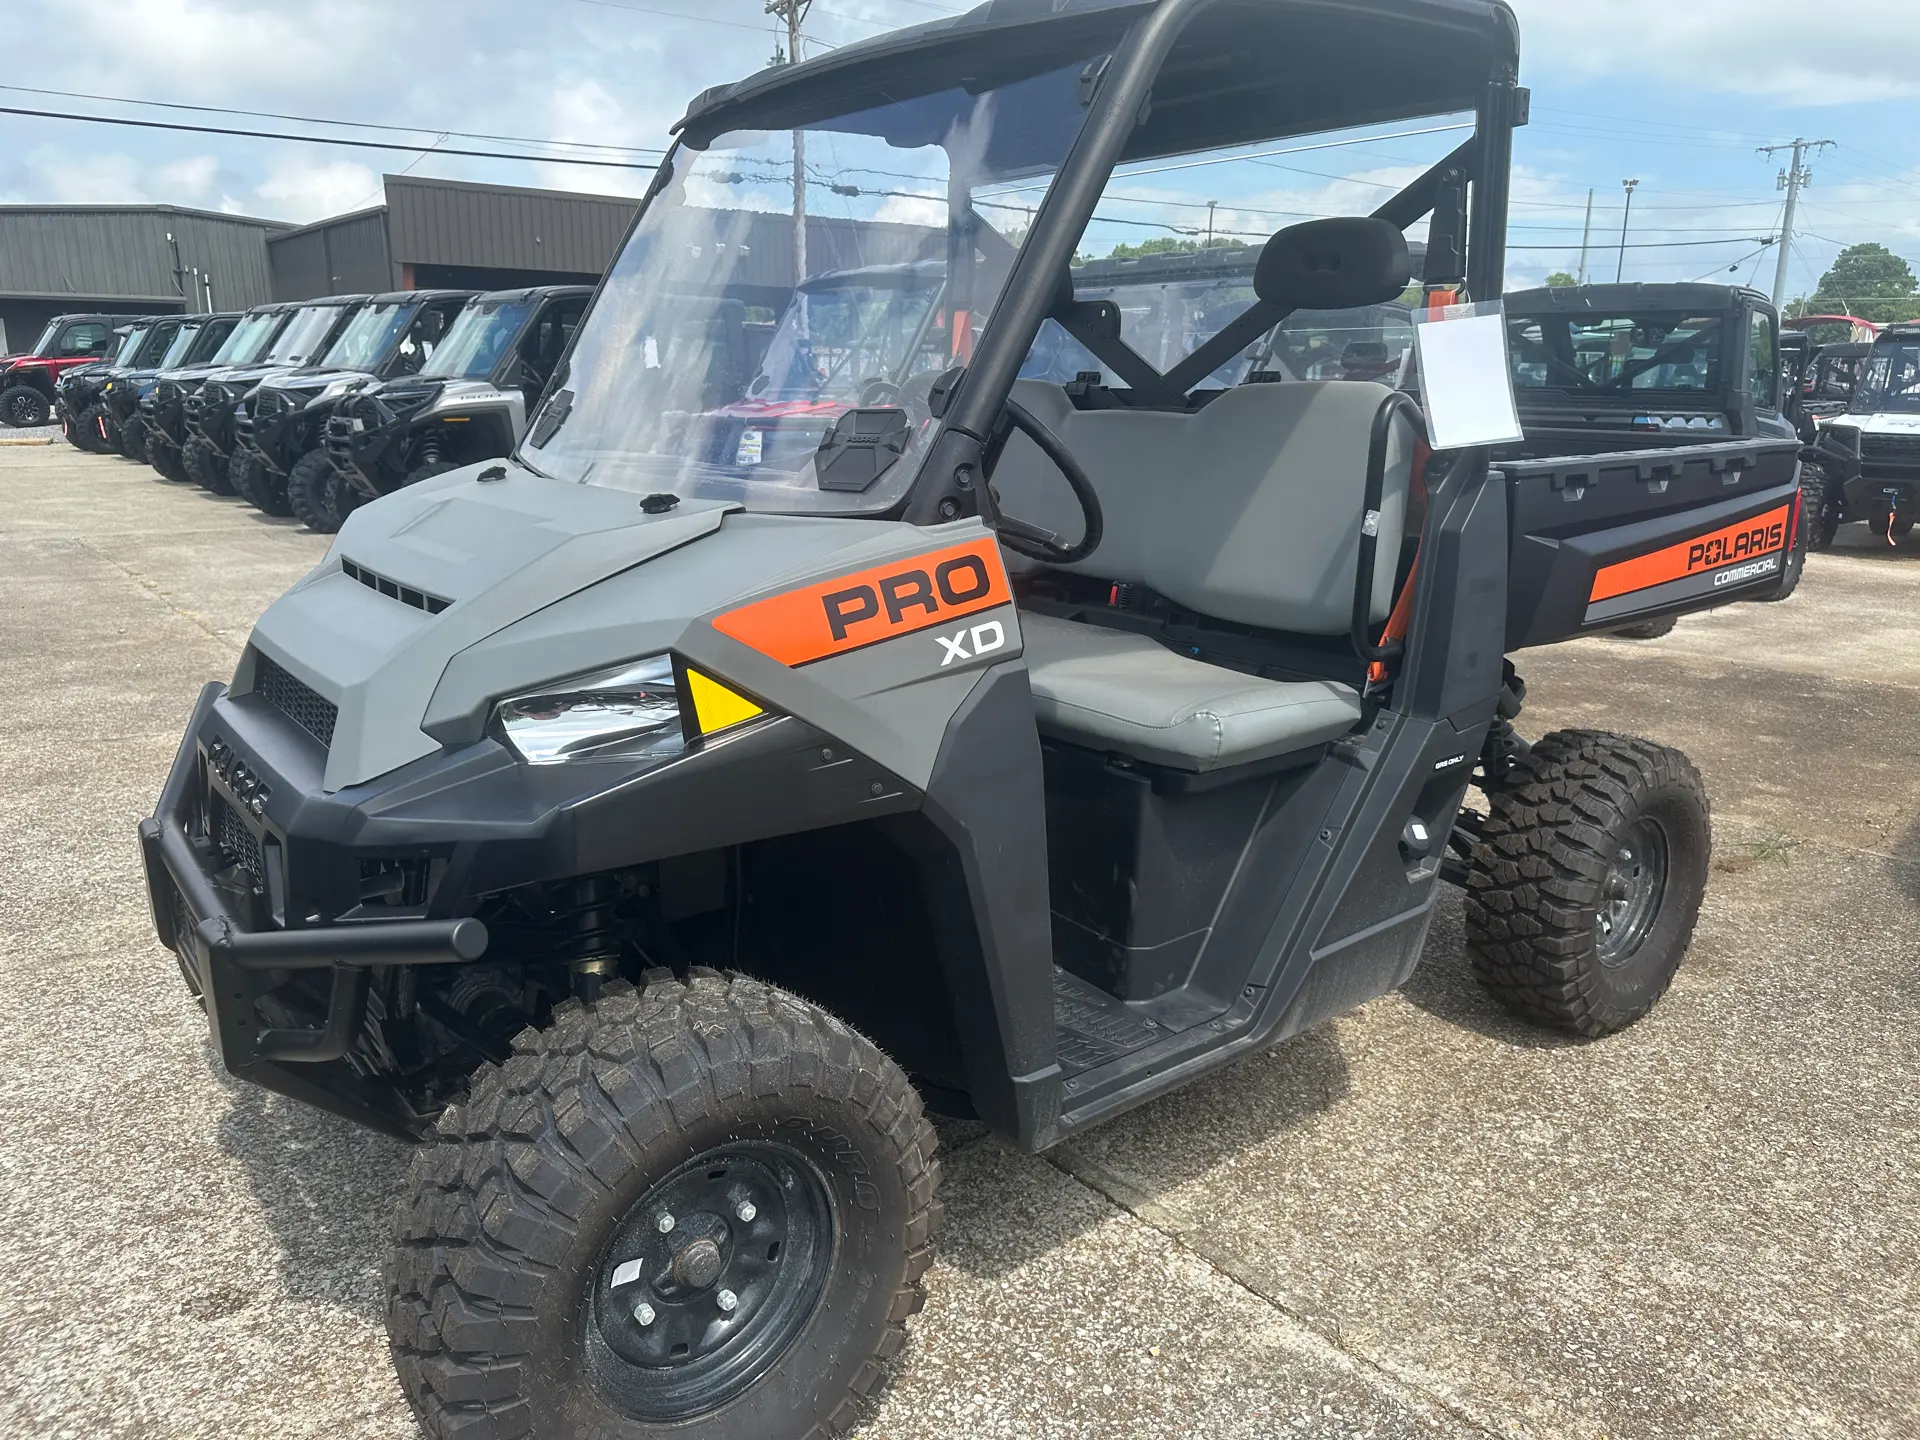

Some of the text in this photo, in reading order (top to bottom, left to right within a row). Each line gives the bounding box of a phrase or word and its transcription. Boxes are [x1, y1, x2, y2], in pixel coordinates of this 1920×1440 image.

[846, 436, 881, 444] POLARIS
[1687, 522, 1783, 571] POLARIS
[1714, 557, 1777, 586] COMMERCIAL
[821, 554, 991, 642] PRO
[935, 620, 1005, 667] XD
[1435, 755, 1464, 770] GAS ONLY
